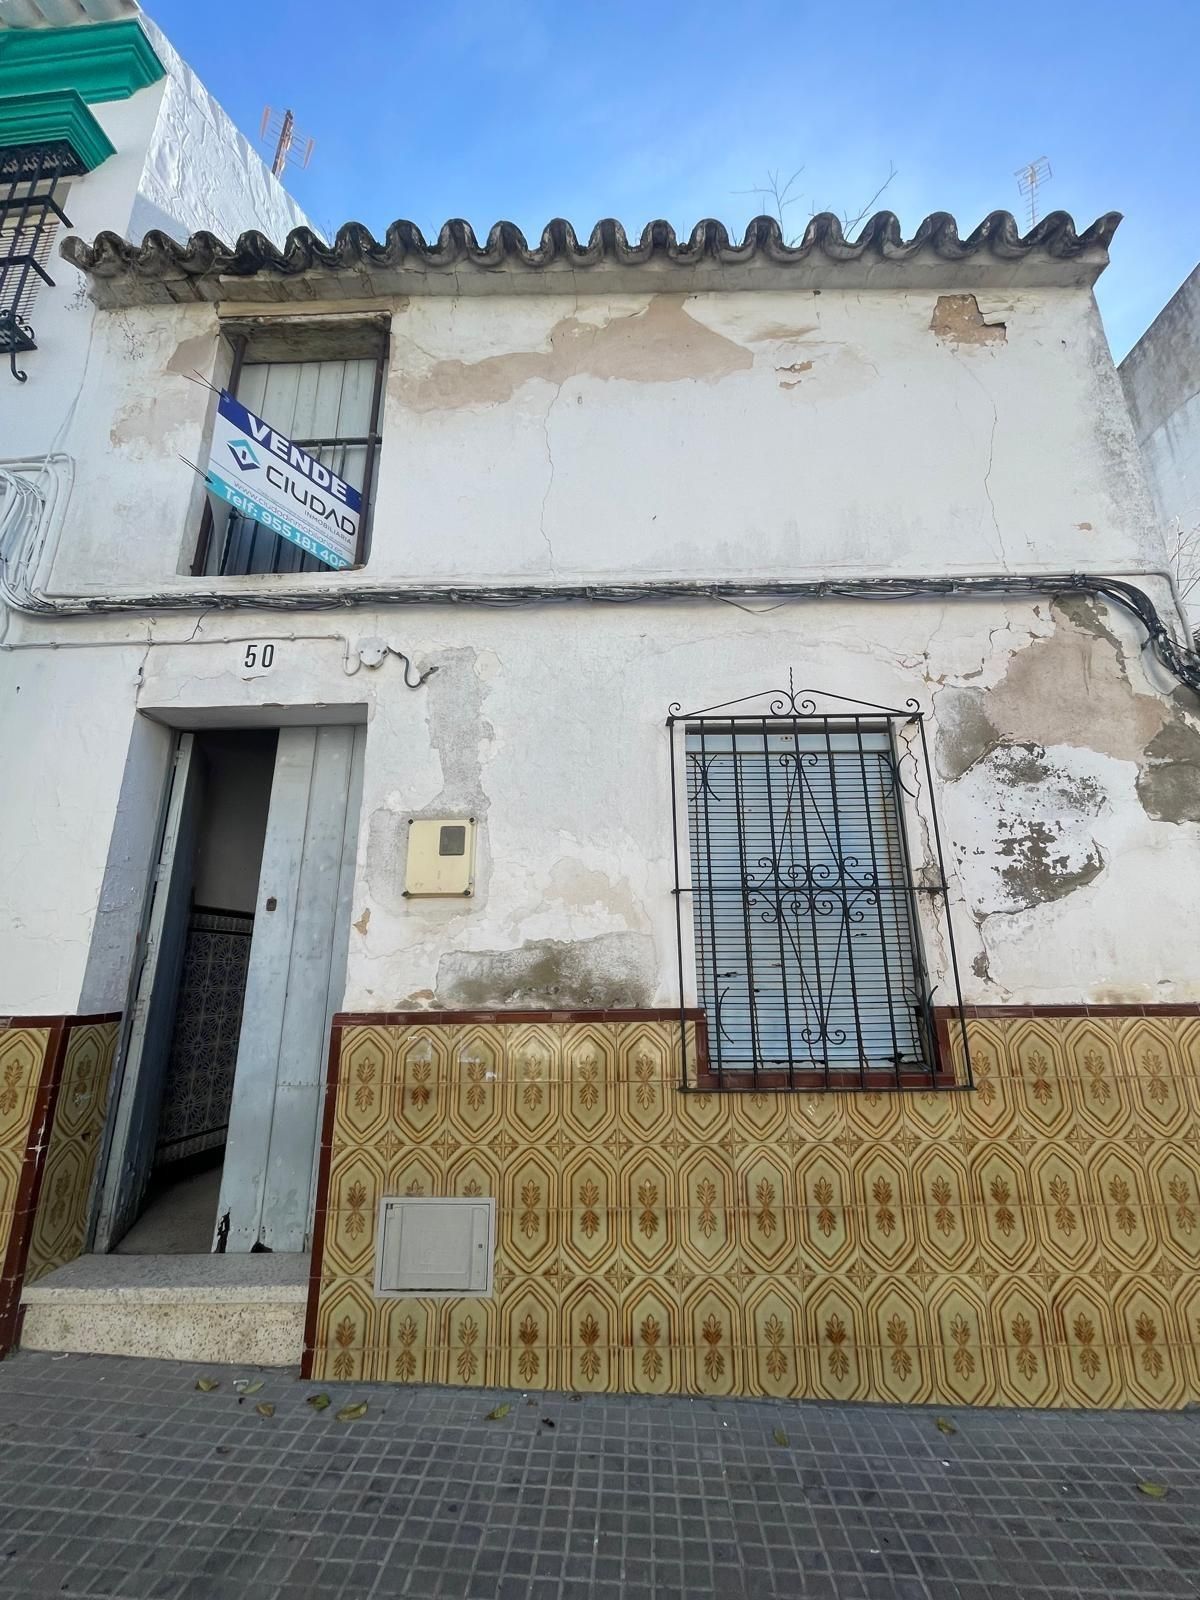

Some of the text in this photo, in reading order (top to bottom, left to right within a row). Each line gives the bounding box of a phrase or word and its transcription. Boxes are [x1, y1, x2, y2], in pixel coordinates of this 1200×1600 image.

[247, 412, 348, 502] VENDE
[224, 485, 258, 517] Telf:
[261, 510, 292, 538] 955
[294, 531, 318, 554] 181
[266, 465, 356, 536] CIUDAD
[304, 509, 352, 545] INMOBILIARIA
[244, 644, 275, 668] 50
